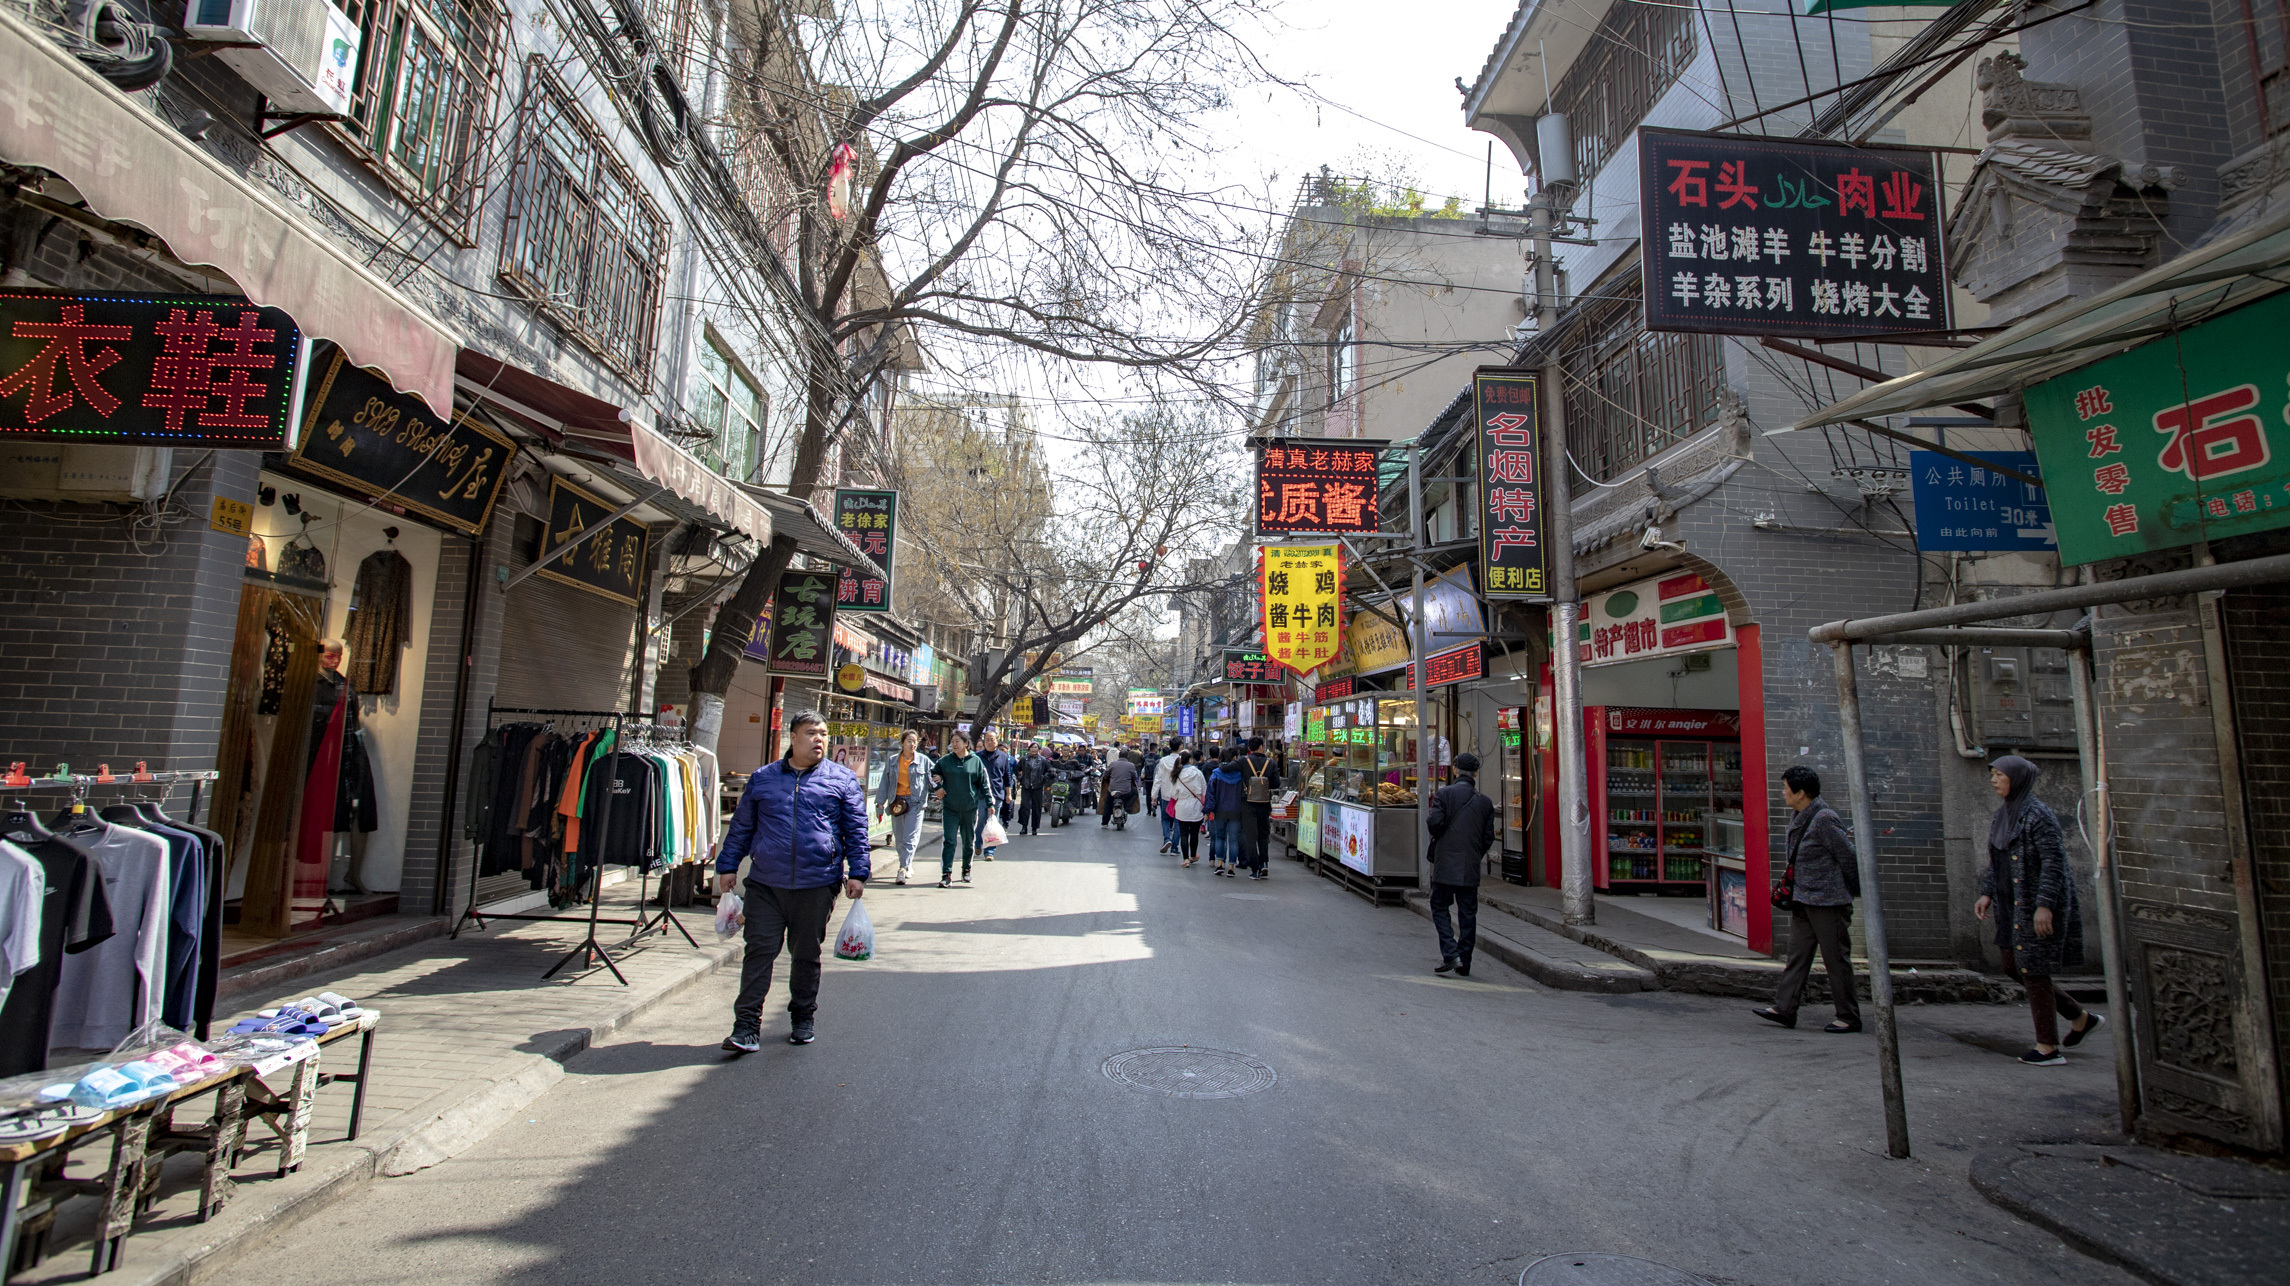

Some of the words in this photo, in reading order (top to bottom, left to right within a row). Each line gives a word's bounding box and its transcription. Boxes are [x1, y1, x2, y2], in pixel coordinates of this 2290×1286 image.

[1667, 159, 1759, 211] 石头
[1763, 172, 1831, 209] حلال
[1837, 167, 1925, 220] 肉业
[1668, 222, 1791, 265] 盐池滩羊
[1808, 230, 1928, 274] 牛羊分割
[1672, 271, 1794, 312] 羊杂系列
[1810, 278, 1931, 320] 烧烤大全
[0, 304, 277, 431] 衣鞋
[1485, 384, 1531, 405] 免费包邮
[2152, 382, 2290, 482] 石
[1264, 447, 1376, 473] 清真老赫家
[2075, 384, 2139, 537] 批发零售
[1486, 411, 1537, 562] 名烟特产
[1925, 465, 2007, 487] 公共厕所
[1262, 481, 1377, 526] 质酱
[1945, 497, 1996, 511] Toilet
[219, 515, 242, 532] 55号
[840, 511, 889, 529] 老徐家
[2000, 506, 2038, 527] 30米
[1941, 527, 1998, 538] 由此向前
[1488, 565, 1541, 589] 便利店
[778, 575, 827, 660] 古玩店
[1269, 602, 1335, 629] 酱牛肉
[1277, 631, 1329, 644] 酱牛筋
[1594, 617, 1658, 659] 特产超市
[1277, 647, 1330, 660] 酱牛肚
[1226, 660, 1282, 681] 饺子面
[1667, 719, 1708, 730] anqier
